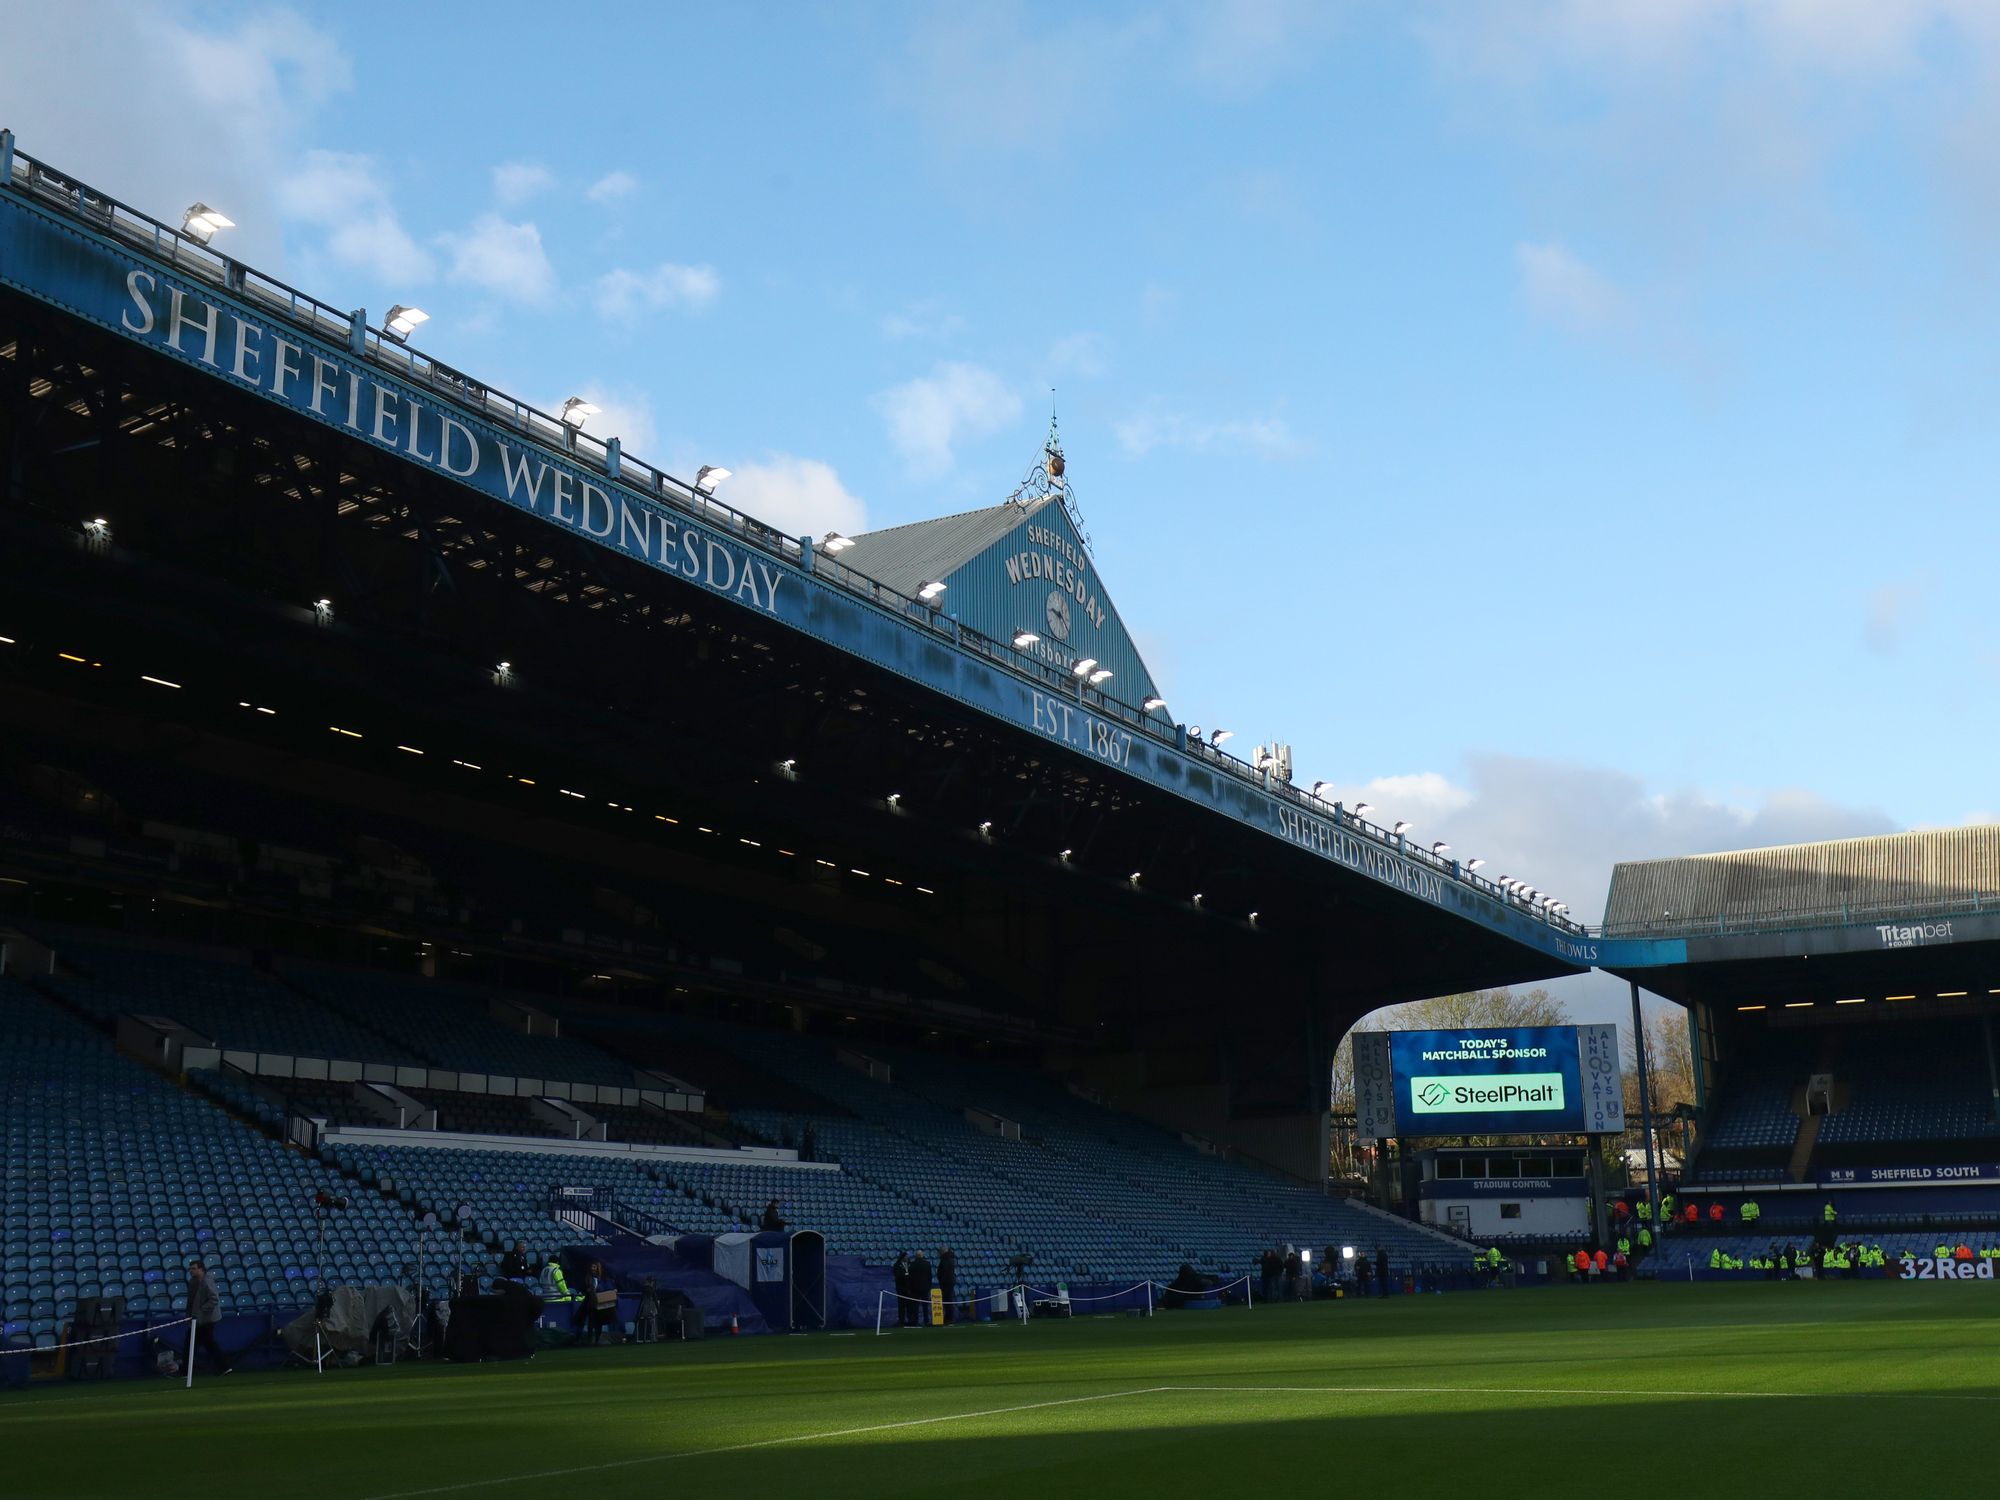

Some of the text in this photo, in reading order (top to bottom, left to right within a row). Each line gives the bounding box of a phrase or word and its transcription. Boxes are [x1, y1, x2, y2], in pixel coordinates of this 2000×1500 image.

[121, 269, 784, 614] SHEFFIELD WEDNESDAY
[1028, 525, 1085, 571] SHEFFIELD
[1005, 551, 1106, 629] WEDNESDAY
[1032, 690, 1132, 767] EST. 1867
[1278, 806, 1442, 904] SHEFFIELD WEDNESDAY
[1876, 921, 1953, 943] Titanbet
[1567, 943, 1597, 960] OWLS
[1422, 1048, 1546, 1061] MATCHBALL SPONSOR
[1459, 1038, 1507, 1049] TODAY'S
[1599, 1030, 1613, 1095] ALLOYS
[1588, 1026, 1604, 1130] INNOVATION
[1455, 1085, 1554, 1104] SteelPhalt
[1871, 1168, 1932, 1180] SHEFFIELD
[1936, 1166, 1980, 1178] SOUTH
[1473, 1180, 1551, 1189] STADIUM CONTROL
[1899, 1257, 1994, 1279] 32Red
